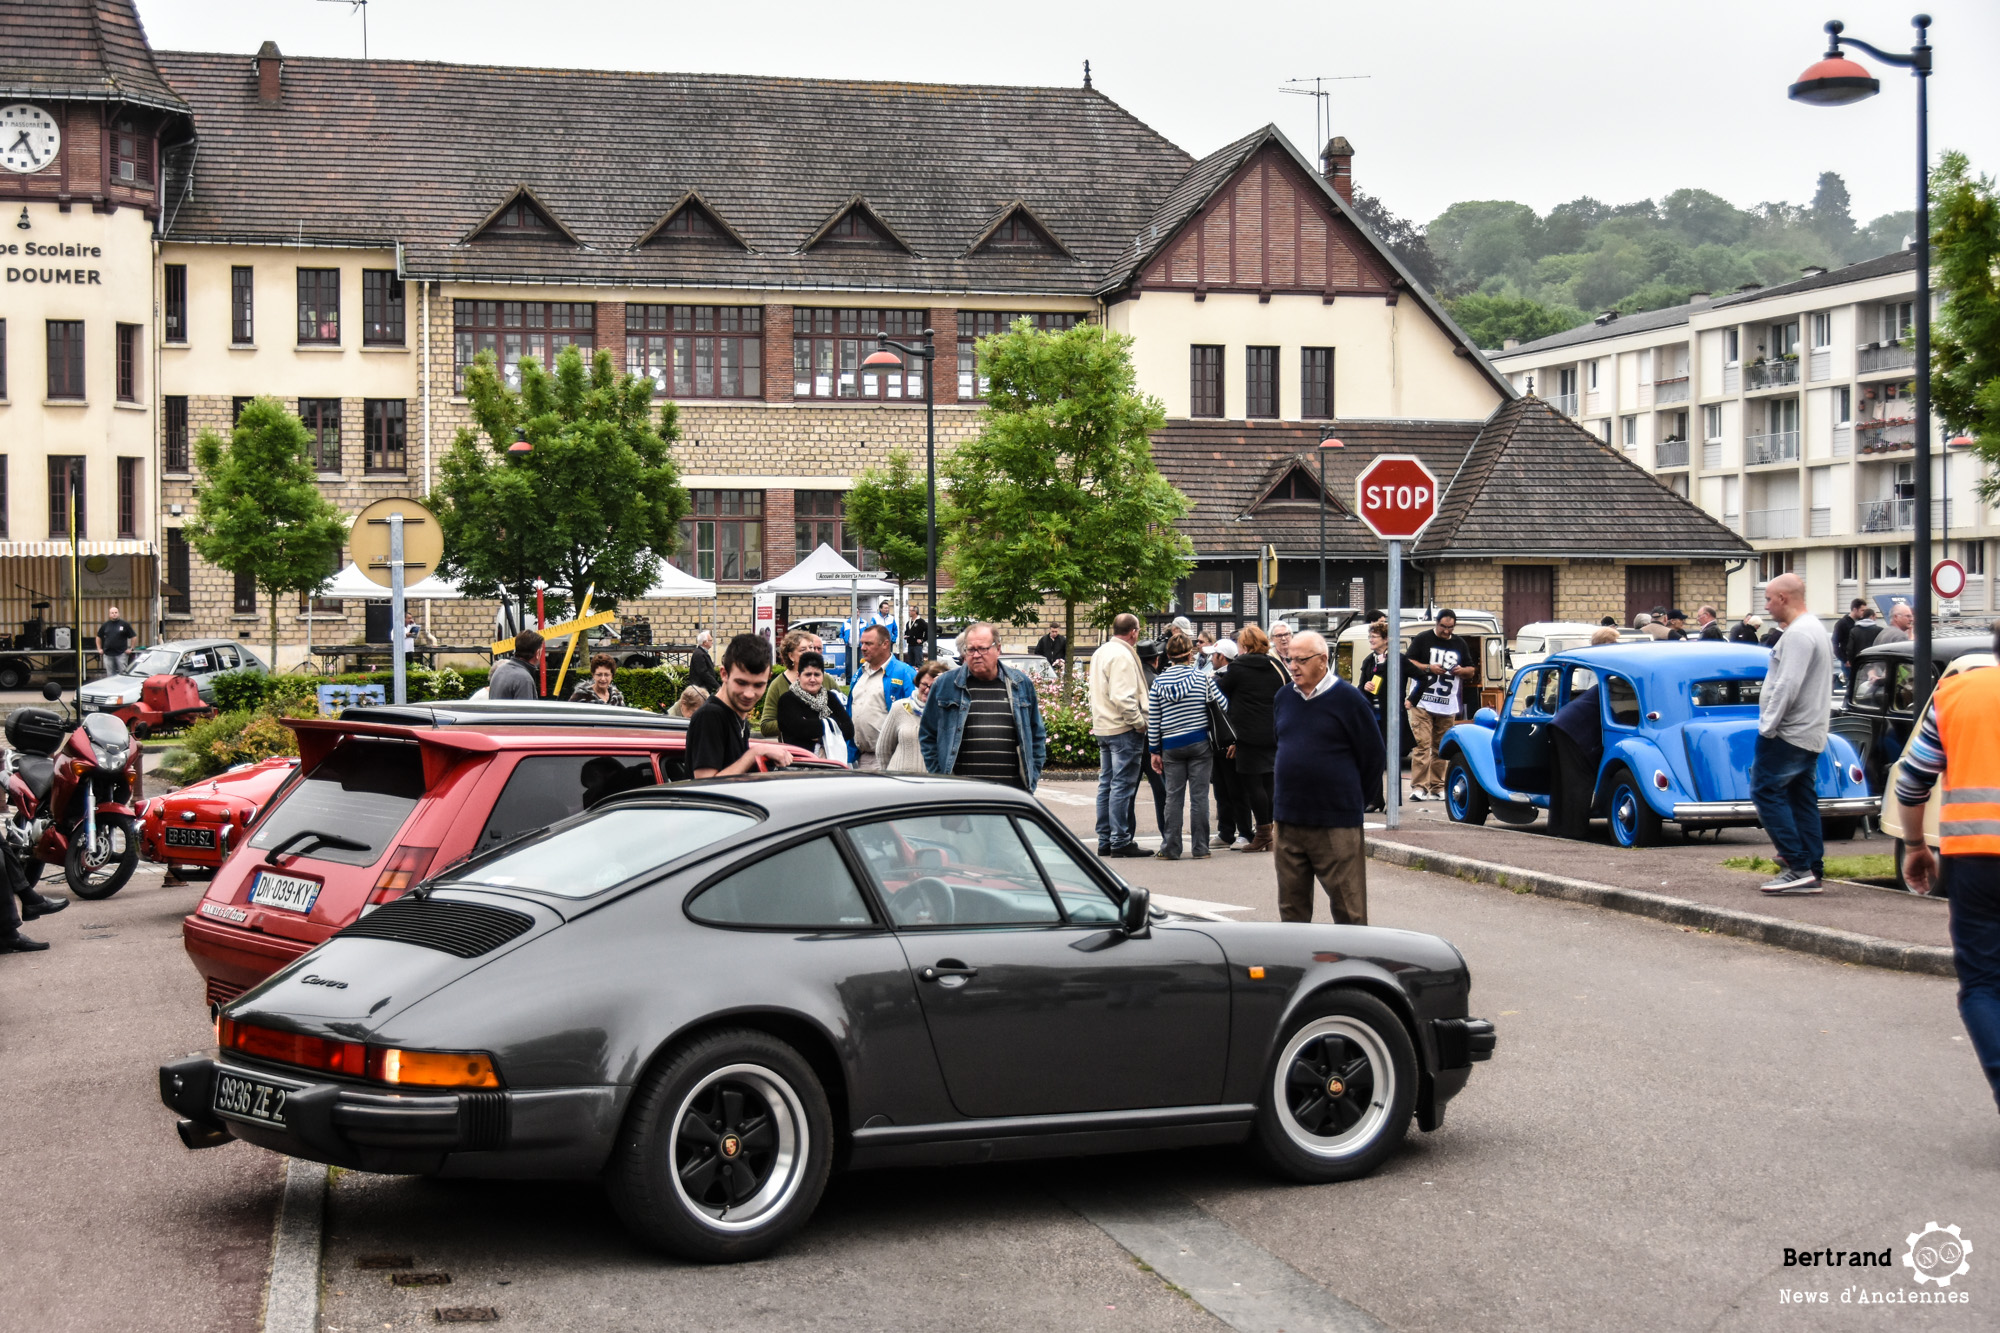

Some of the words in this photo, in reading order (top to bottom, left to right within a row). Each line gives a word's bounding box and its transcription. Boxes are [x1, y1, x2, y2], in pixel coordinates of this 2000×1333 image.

[25, 242, 102, 258] Scolaire
[7, 267, 102, 285] DOUMER
[1366, 485, 1429, 509] STOP
[1429, 648, 1458, 670] US
[168, 828, 211, 846] EB-519-SZ
[256, 876, 312, 906] DN-039-KY
[220, 1077, 252, 1113] 9936
[252, 1084, 273, 1118] ZE
[273, 1089, 287, 1121] 2
